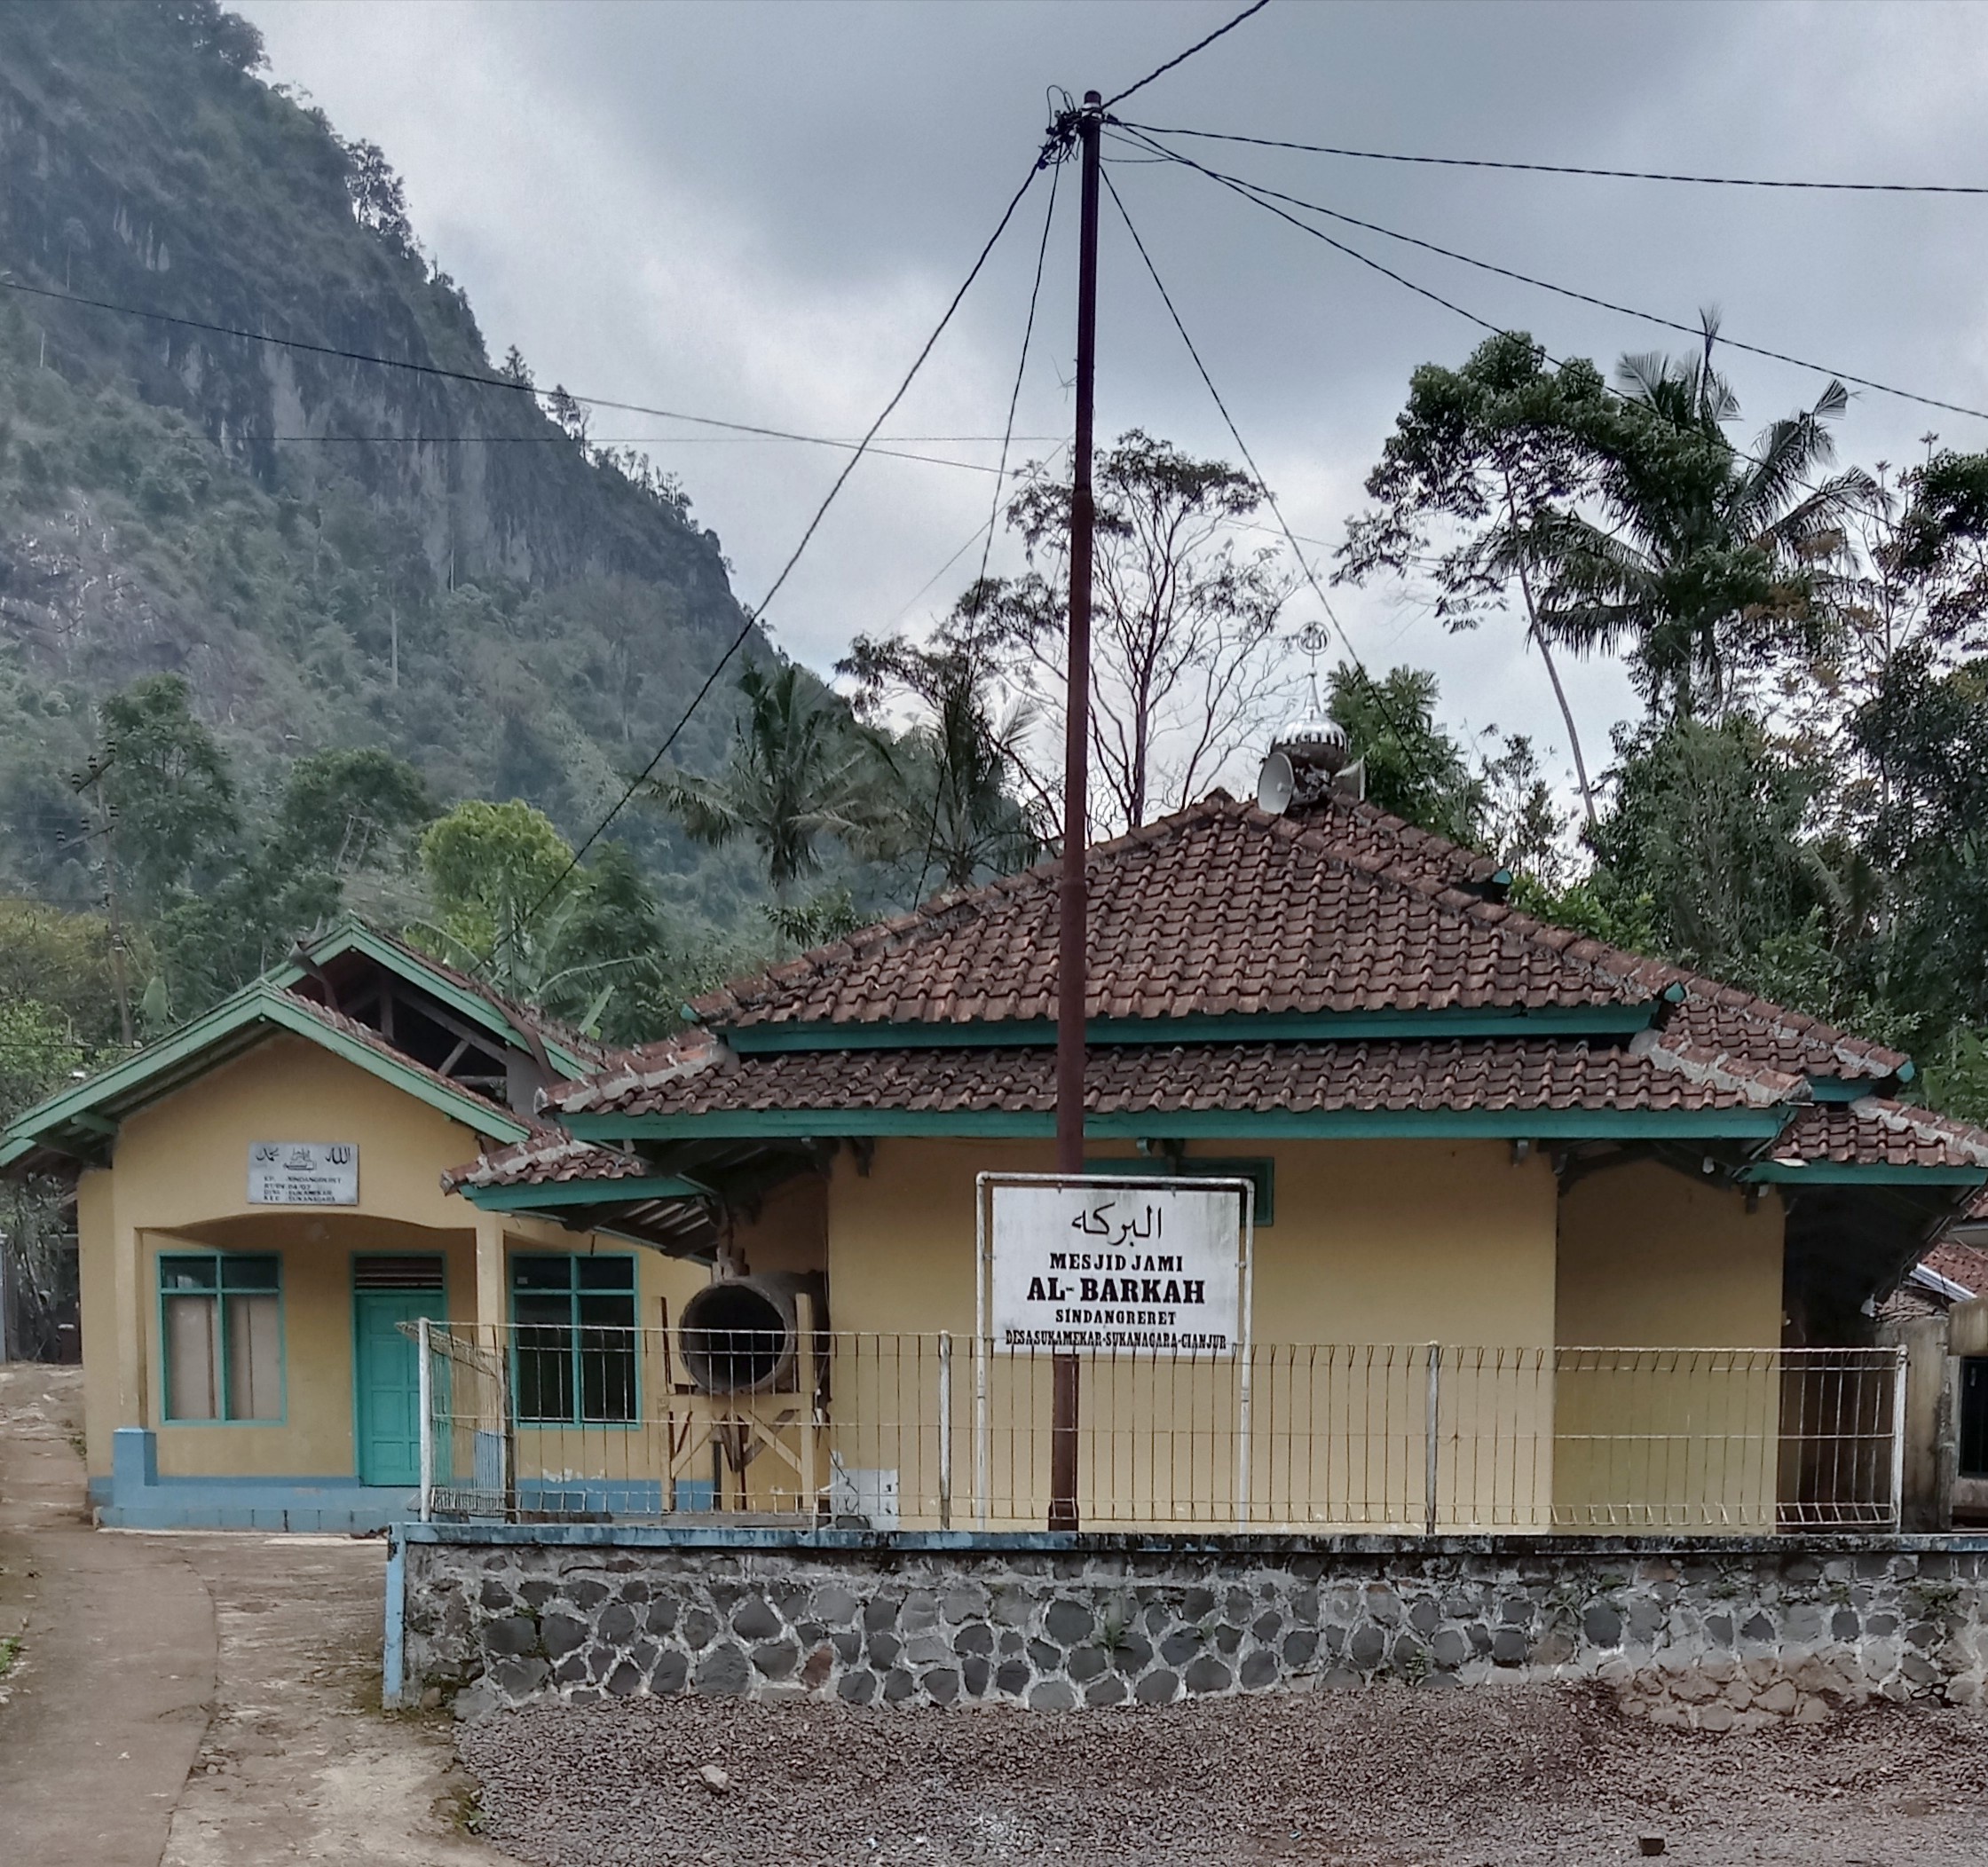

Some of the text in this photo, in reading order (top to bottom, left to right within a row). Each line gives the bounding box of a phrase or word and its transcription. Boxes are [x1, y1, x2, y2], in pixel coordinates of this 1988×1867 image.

[1049, 1252, 1184, 1272] MESJID JAMI
[1055, 1309, 1177, 1326] SINDANGRERET
